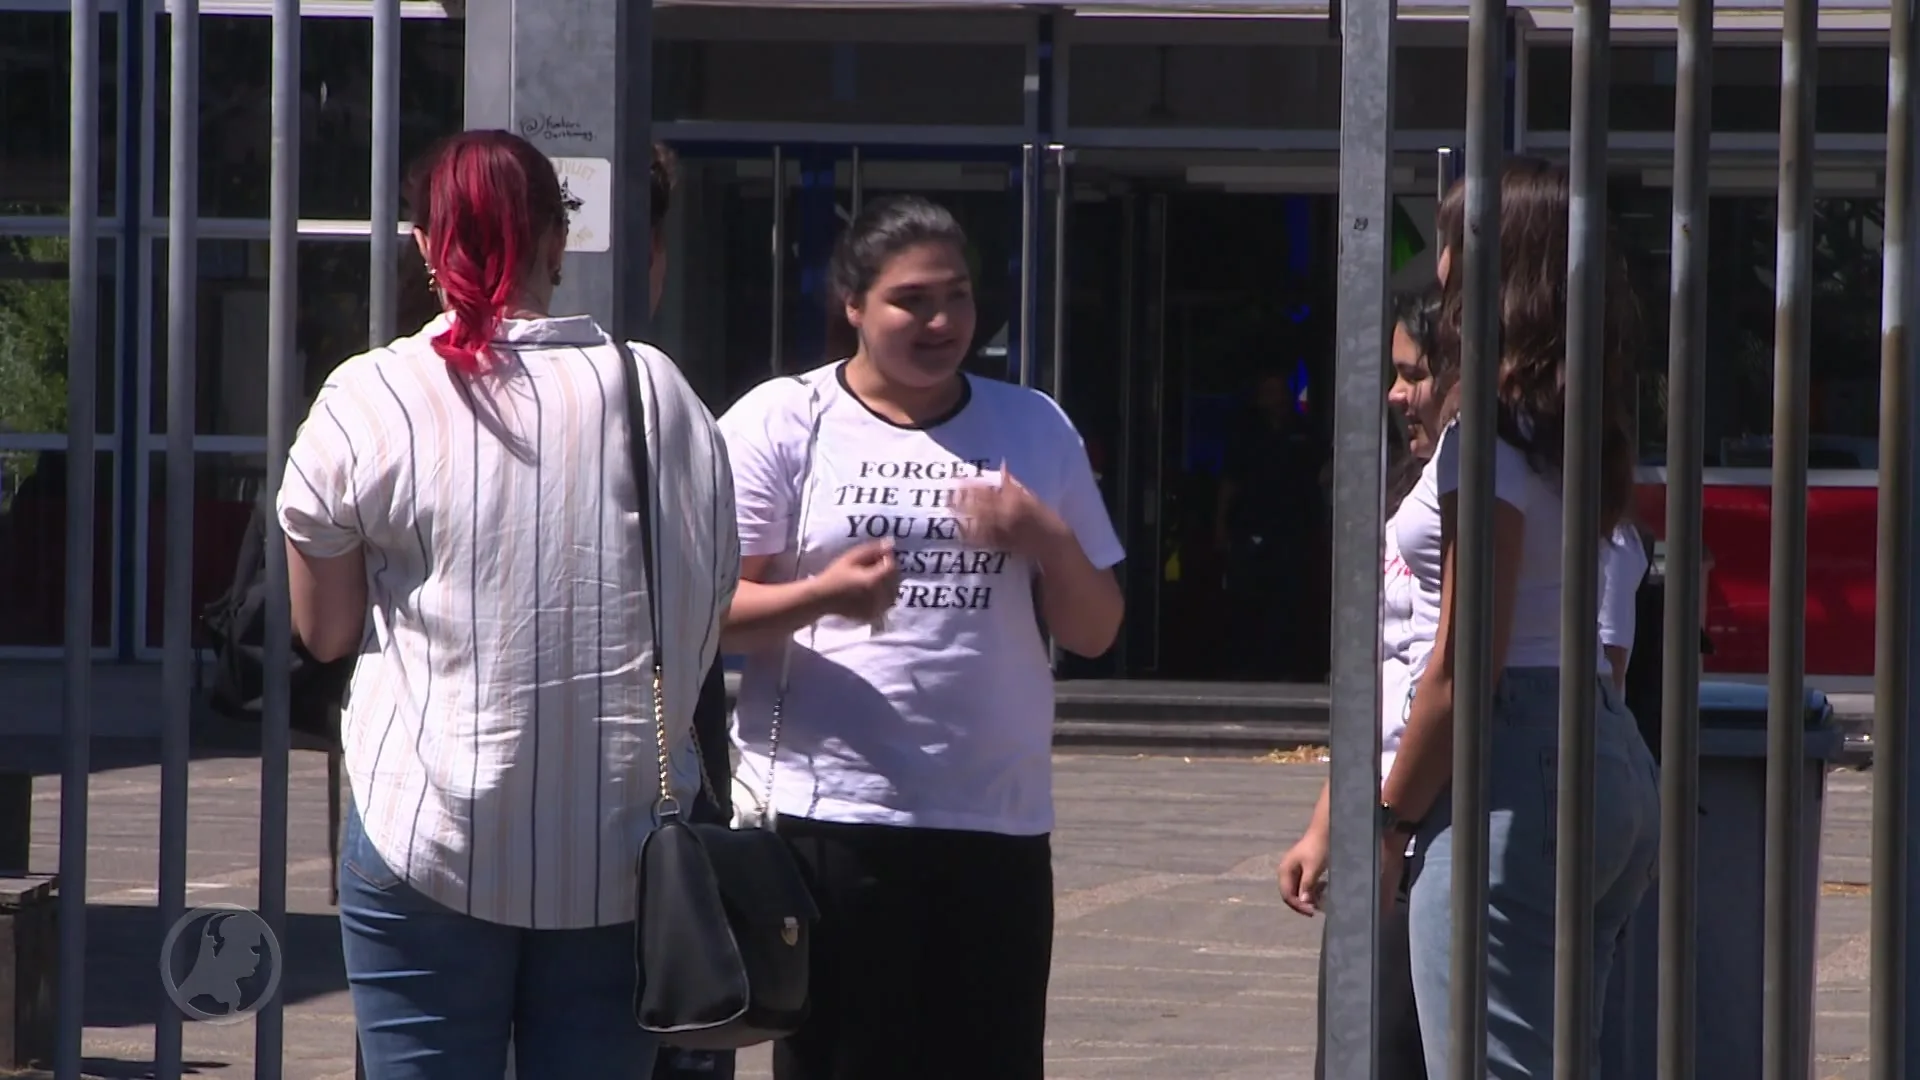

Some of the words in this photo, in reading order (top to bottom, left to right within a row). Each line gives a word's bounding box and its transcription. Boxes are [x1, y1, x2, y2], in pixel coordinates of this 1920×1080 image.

[860, 459, 990, 479] FORGET
[835, 485, 899, 506] THE
[847, 515, 914, 539] YOU
[893, 551, 1012, 575] ESTART
